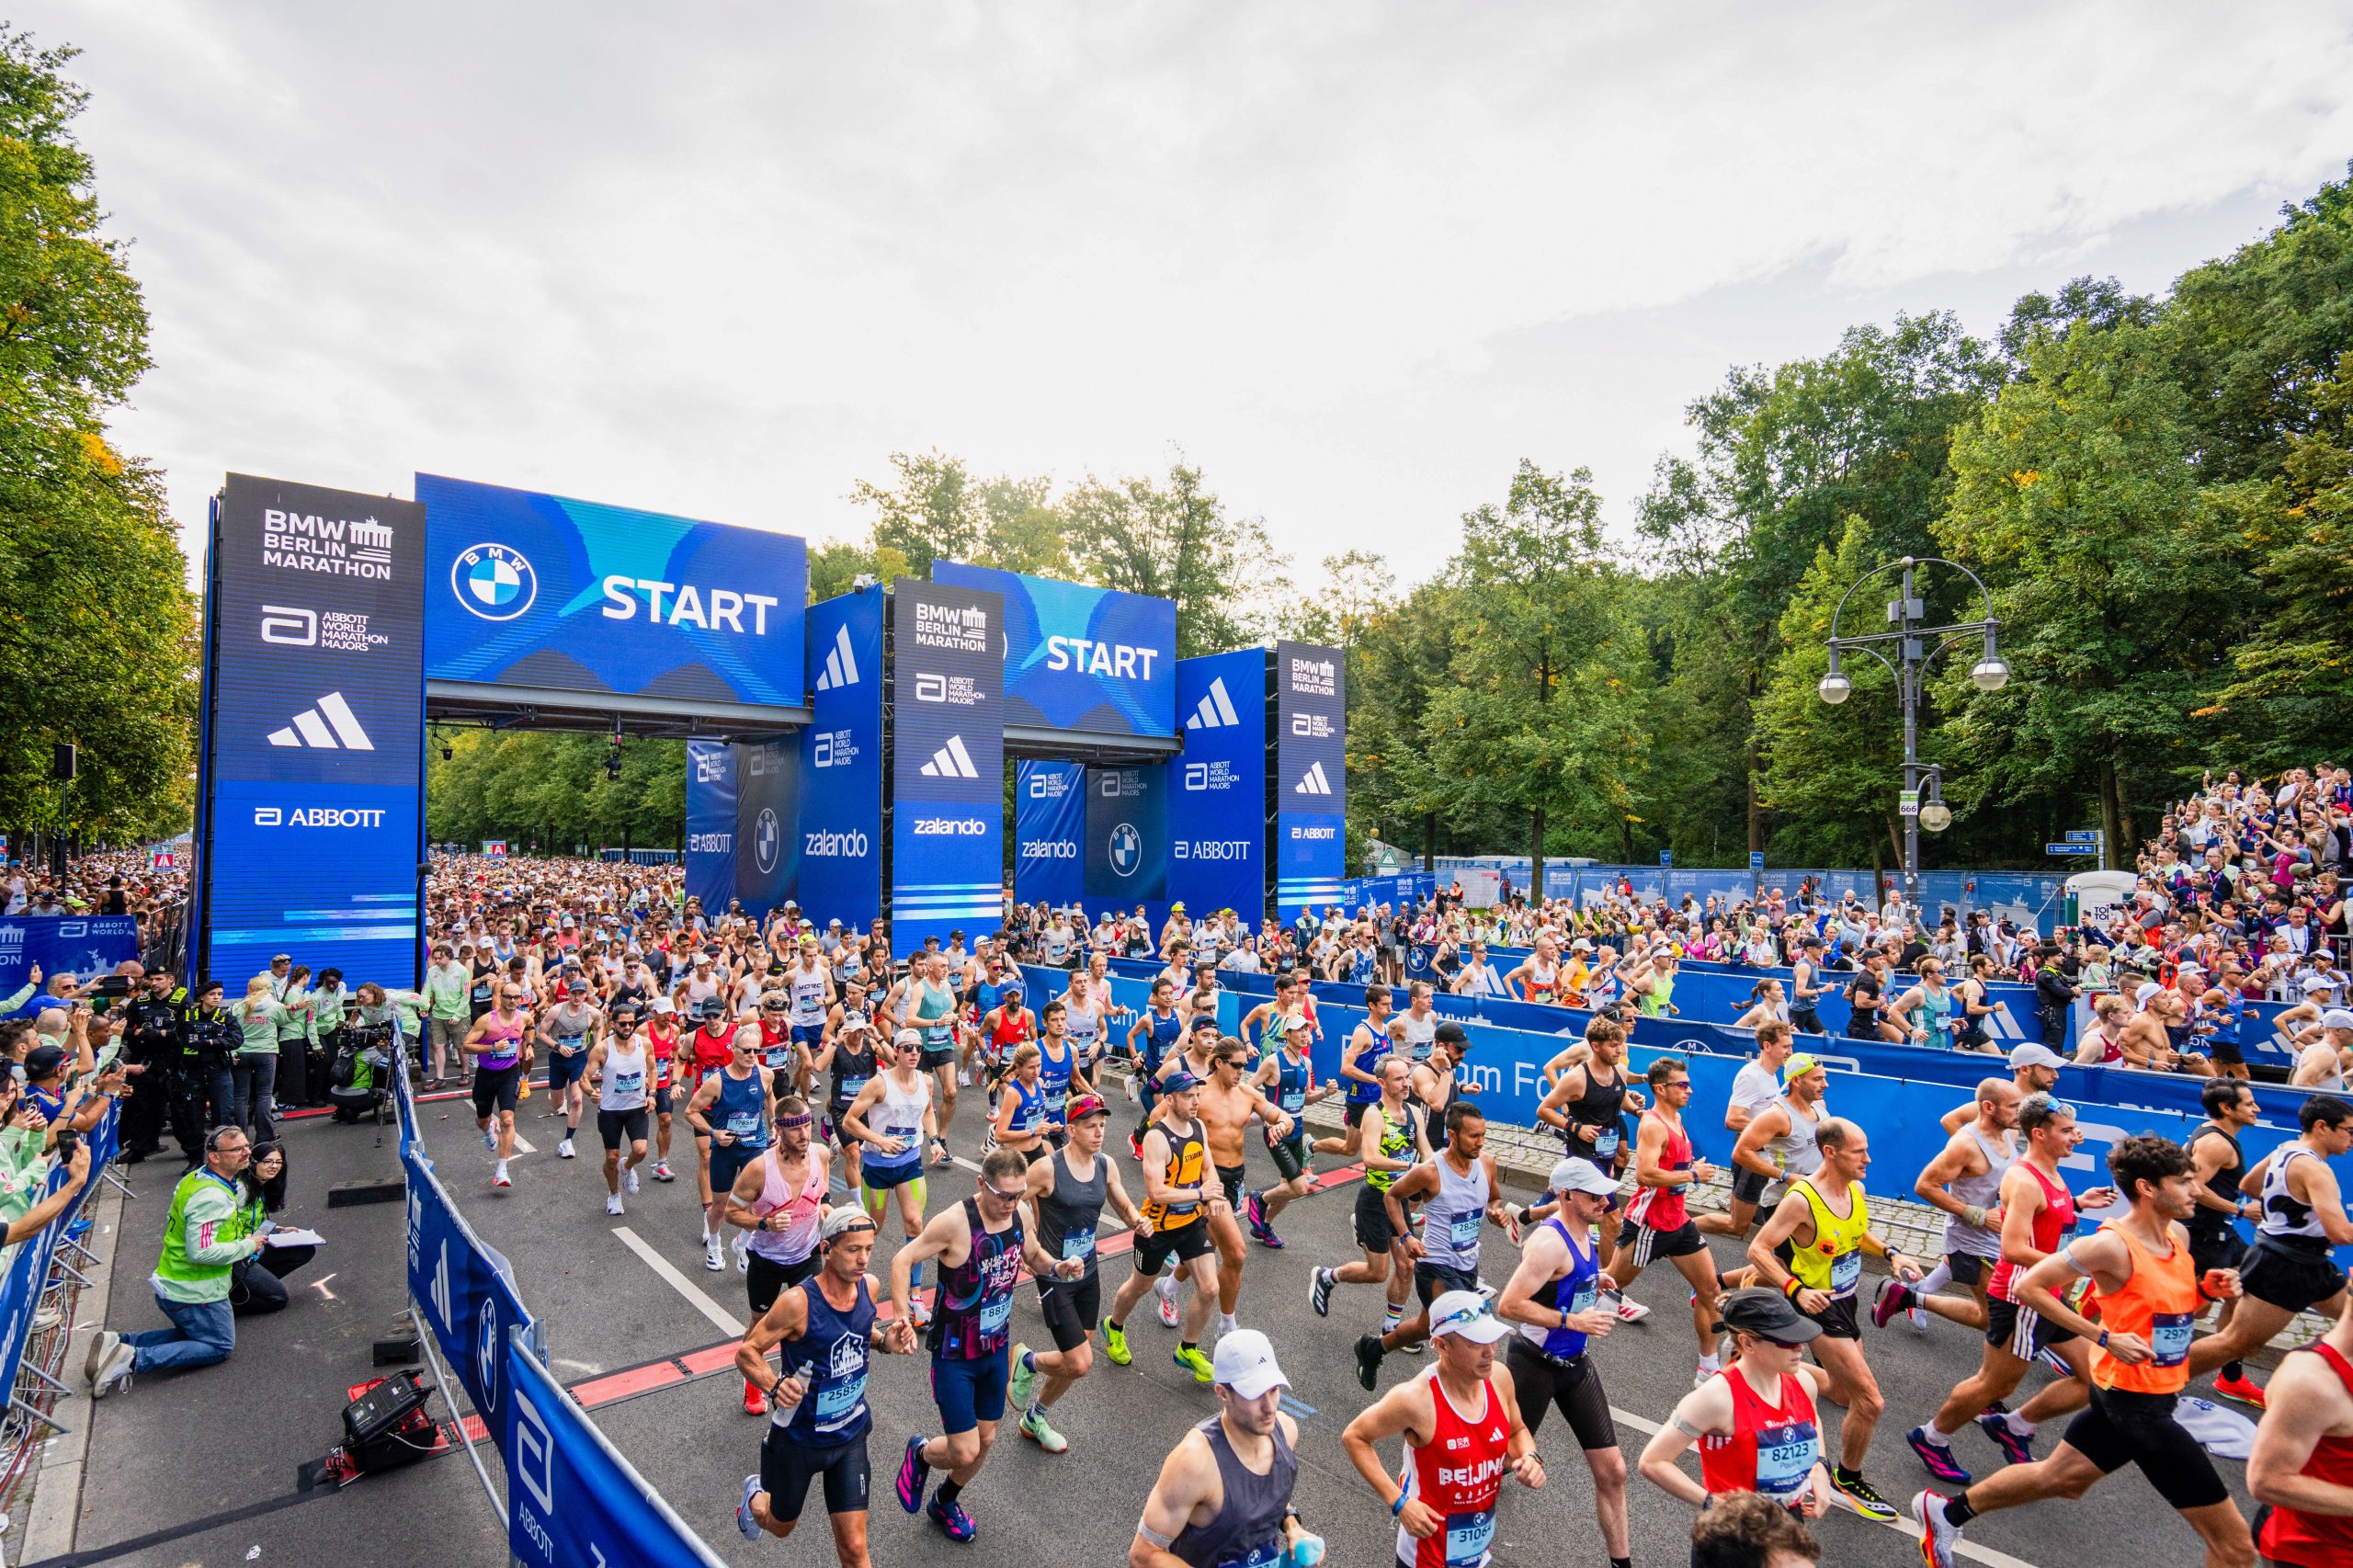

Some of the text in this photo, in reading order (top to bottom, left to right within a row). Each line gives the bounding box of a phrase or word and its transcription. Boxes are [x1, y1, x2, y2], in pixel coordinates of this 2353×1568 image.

[265, 509, 346, 540] BMW
[264, 533, 346, 558] BERLIN
[264, 550, 391, 580] MARATHON
[465, 548, 526, 572] BMW
[602, 574, 779, 635] START
[322, 611, 369, 624] ABBOTT
[916, 603, 961, 623] BMW
[322, 621, 366, 633] WORLD
[916, 620, 961, 636] BERLIN
[322, 630, 388, 645] MARATHON
[322, 639, 369, 652] MAJORS
[916, 634, 986, 652] MARATHON
[1047, 635, 1158, 681] START
[1292, 658, 1319, 673] BMW
[949, 676, 974, 686] ABBOTT
[1292, 672, 1319, 684] BERLIN
[949, 689, 985, 699] MARATHON
[1292, 683, 1334, 696] MARATHON
[949, 696, 974, 705] MAJORS
[835, 729, 852, 739] ABBOTT
[834, 746, 859, 757] MARATHON
[835, 739, 851, 748] WORLD
[834, 756, 852, 766] MAJORS
[1209, 781, 1230, 790] MAJORS
[288, 808, 386, 830] ABBOTT
[914, 818, 986, 835] zalando
[1303, 828, 1335, 839] ABBOTT
[699, 834, 732, 853] ABBOTT
[806, 828, 868, 858] zalando
[1022, 839, 1076, 858] zalando
[1192, 841, 1250, 860] ABBOTT
[846, 1362, 862, 1372] DIEGO
[828, 1380, 862, 1401] 25859
[1772, 1443, 1809, 1462] 82123
[519, 1501, 554, 1564] ABBOTT
